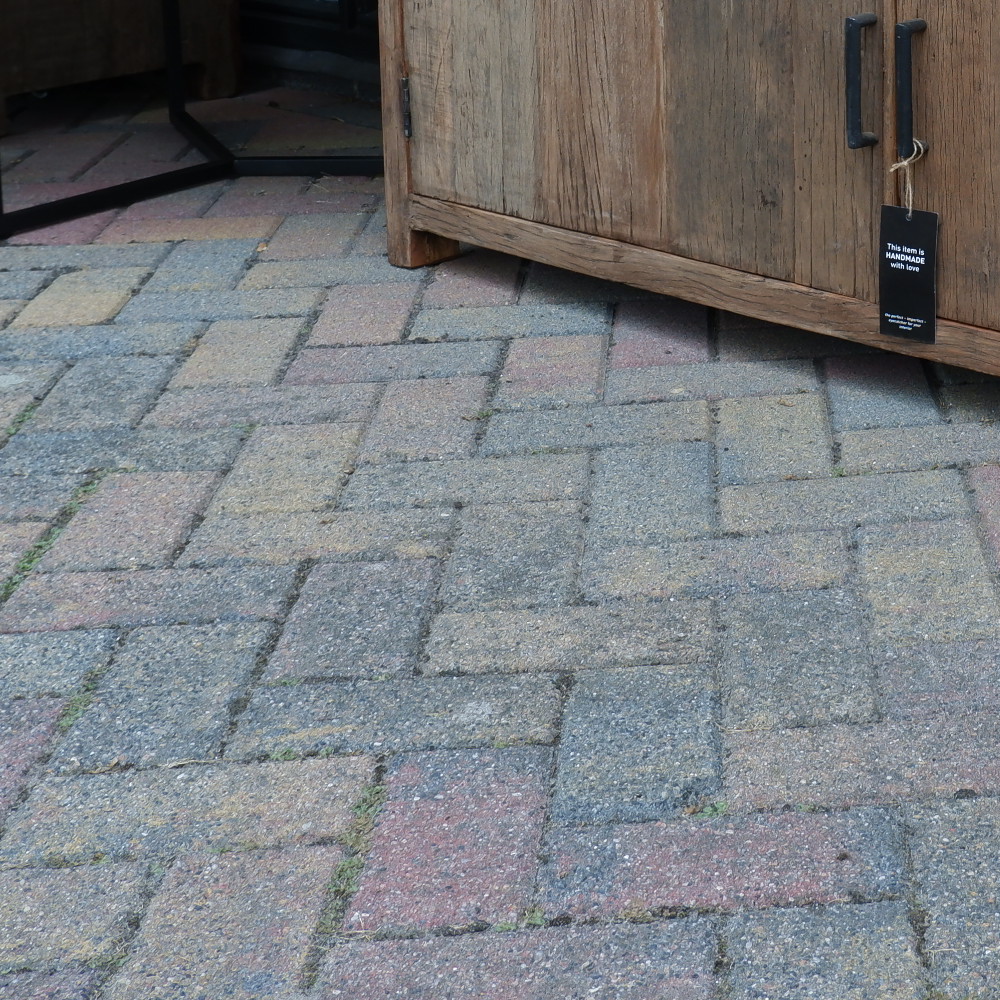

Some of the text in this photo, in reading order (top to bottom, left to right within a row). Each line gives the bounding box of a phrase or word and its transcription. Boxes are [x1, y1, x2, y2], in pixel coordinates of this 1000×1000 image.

[887, 243, 901, 251] This
[902, 245, 917, 254] item
[886, 251, 925, 264] HANDMADE
[906, 264, 919, 272] love
